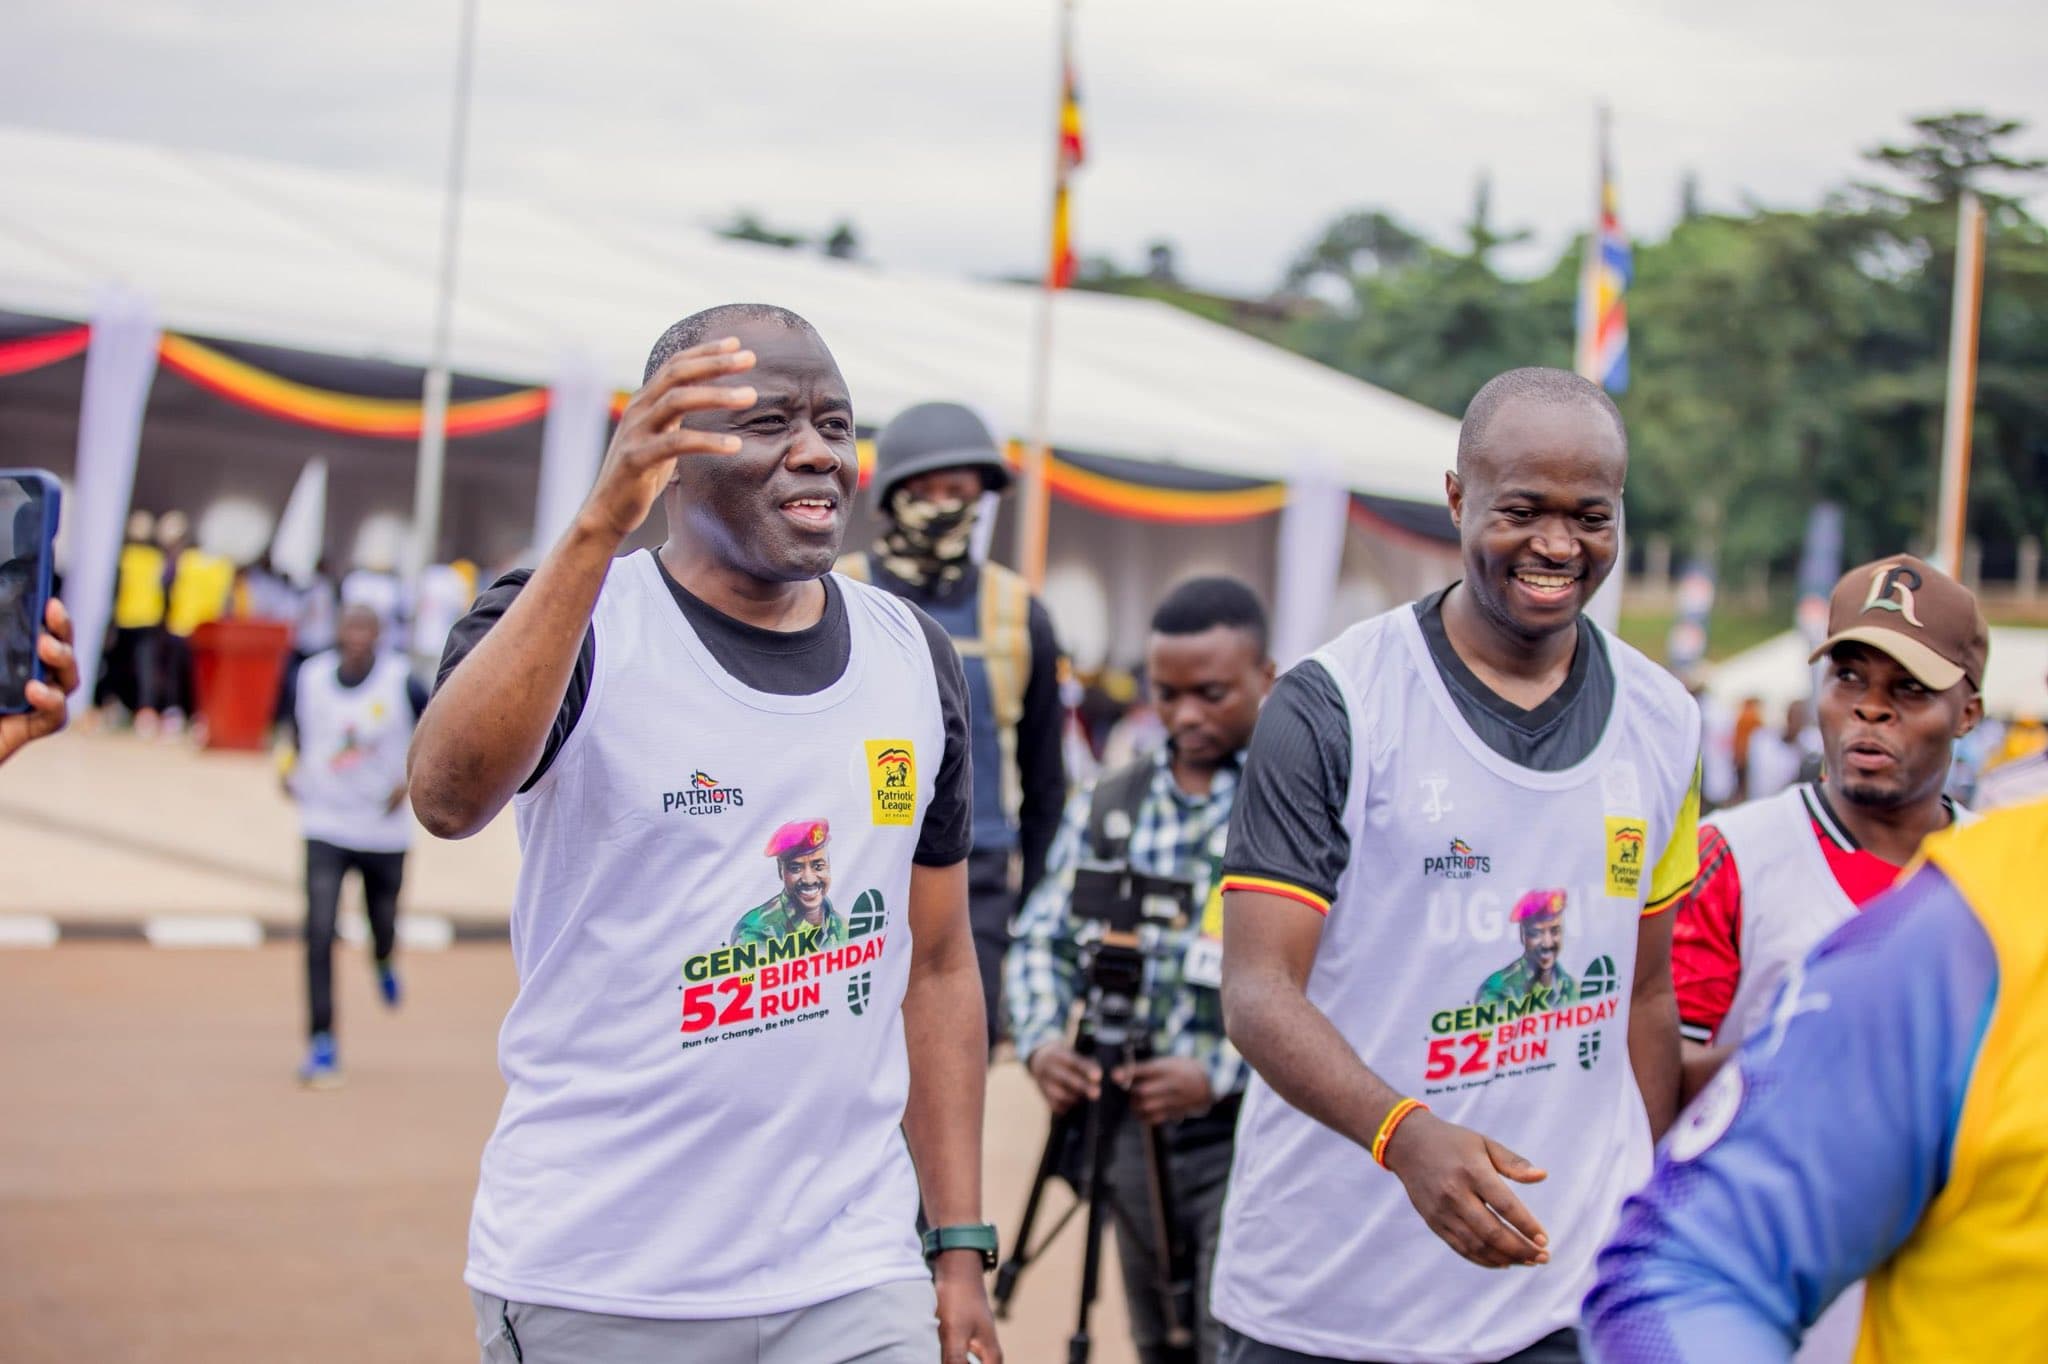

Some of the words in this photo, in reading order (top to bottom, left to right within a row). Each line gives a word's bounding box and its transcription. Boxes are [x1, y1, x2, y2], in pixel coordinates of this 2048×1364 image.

[663, 788, 744, 813] PATRIOTS
[688, 805, 722, 816] CLUB
[877, 789, 914, 802] Patriotic
[881, 799, 912, 812] League
[1424, 855, 1491, 876] PATRIOTS
[683, 926, 823, 982] GEN.MK
[760, 934, 889, 991] BIRTHDAY
[760, 982, 821, 1019] RUN
[1430, 988, 1550, 1034] GEN.MK
[682, 1039, 702, 1050] Run
[704, 1035, 720, 1045] for
[721, 1026, 763, 1041] Change,
[765, 1022, 778, 1031] Be
[780, 1018, 795, 1027] the
[797, 1009, 830, 1023] Change
[1497, 997, 1620, 1046] BIRTHDAY
[1496, 1038, 1549, 1068] RUN
